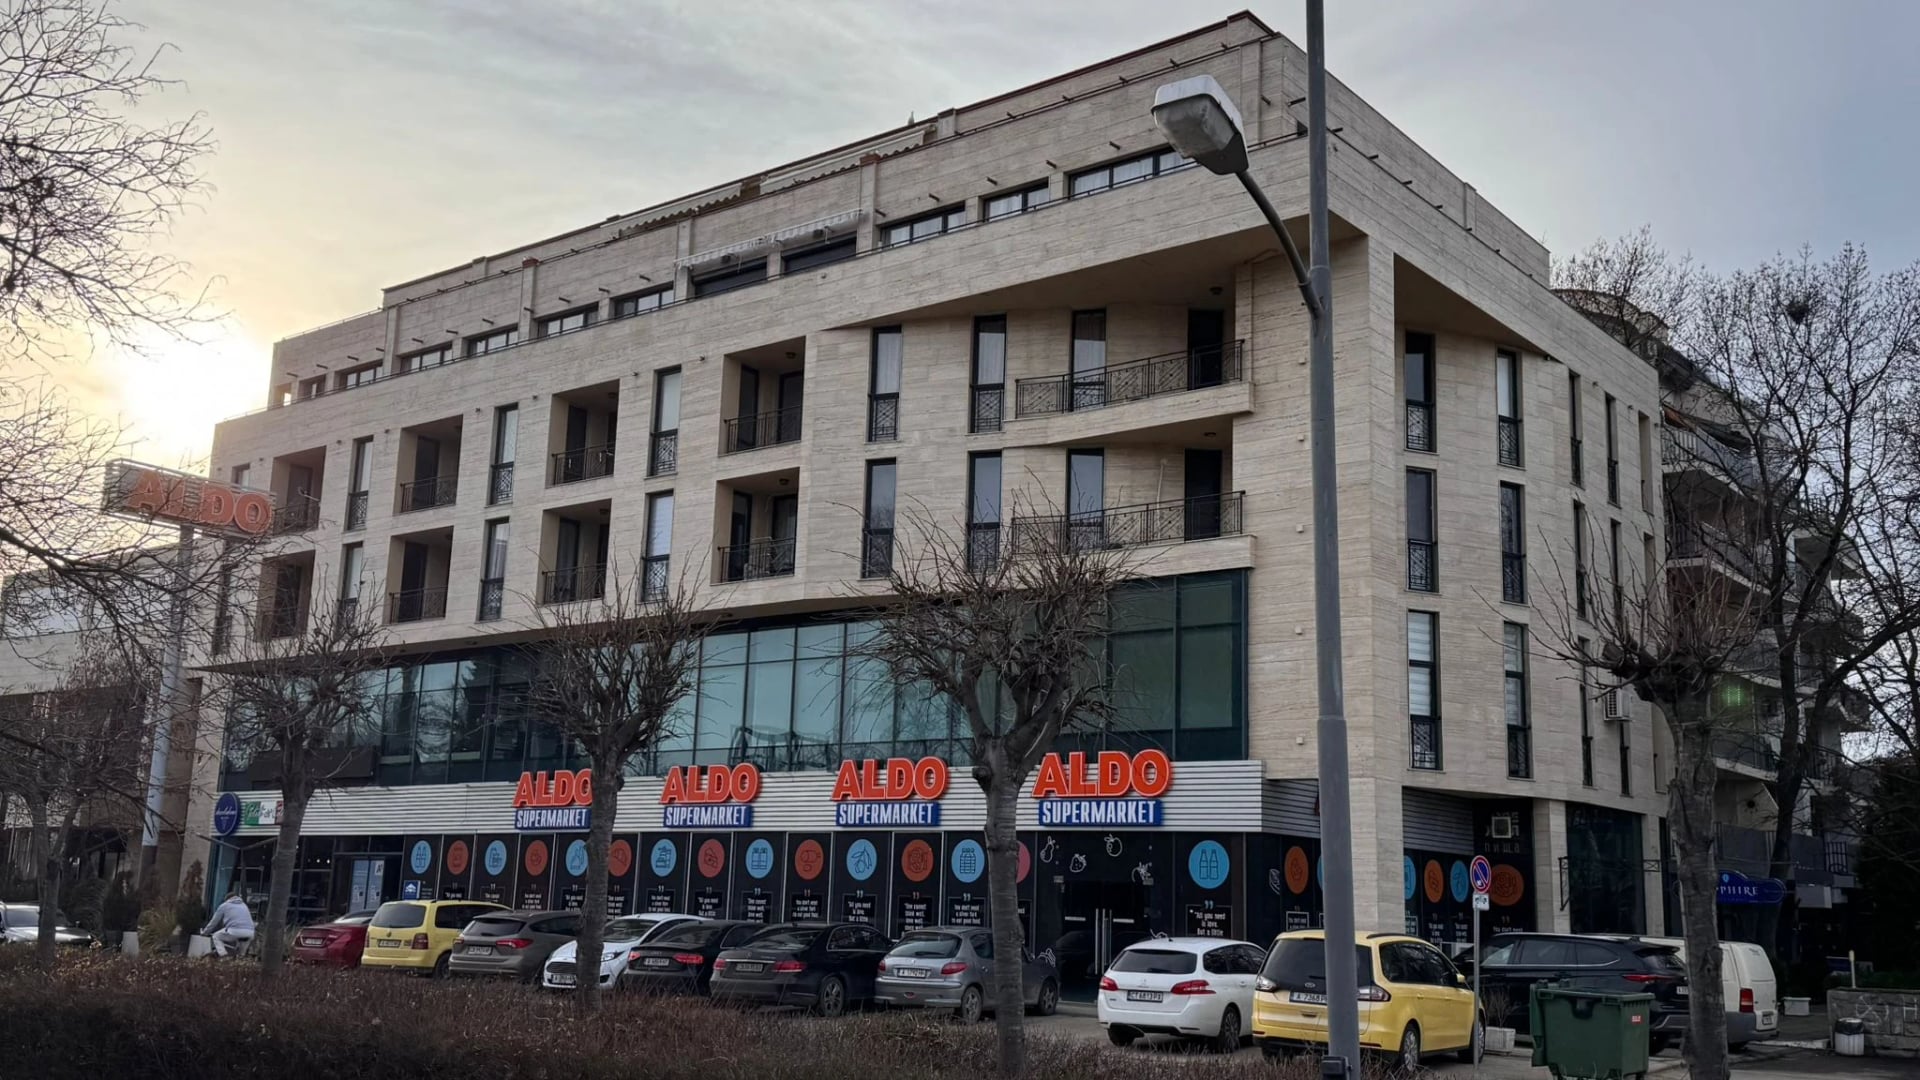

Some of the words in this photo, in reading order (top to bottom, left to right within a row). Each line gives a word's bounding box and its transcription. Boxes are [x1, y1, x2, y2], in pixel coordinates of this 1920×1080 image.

[126, 469, 272, 534] ALDO
[512, 768, 592, 807] ALDO
[660, 762, 758, 803] ALDO
[831, 756, 946, 800] ALDO
[1032, 749, 1170, 797] ALDO
[516, 809, 587, 828] SUPERMARKET
[666, 806, 747, 826] SUPERMARKET
[839, 803, 934, 824] SUPERMARKET
[1042, 800, 1156, 823] SUPERMARKET
[1716, 886, 1758, 896] PHIRE
